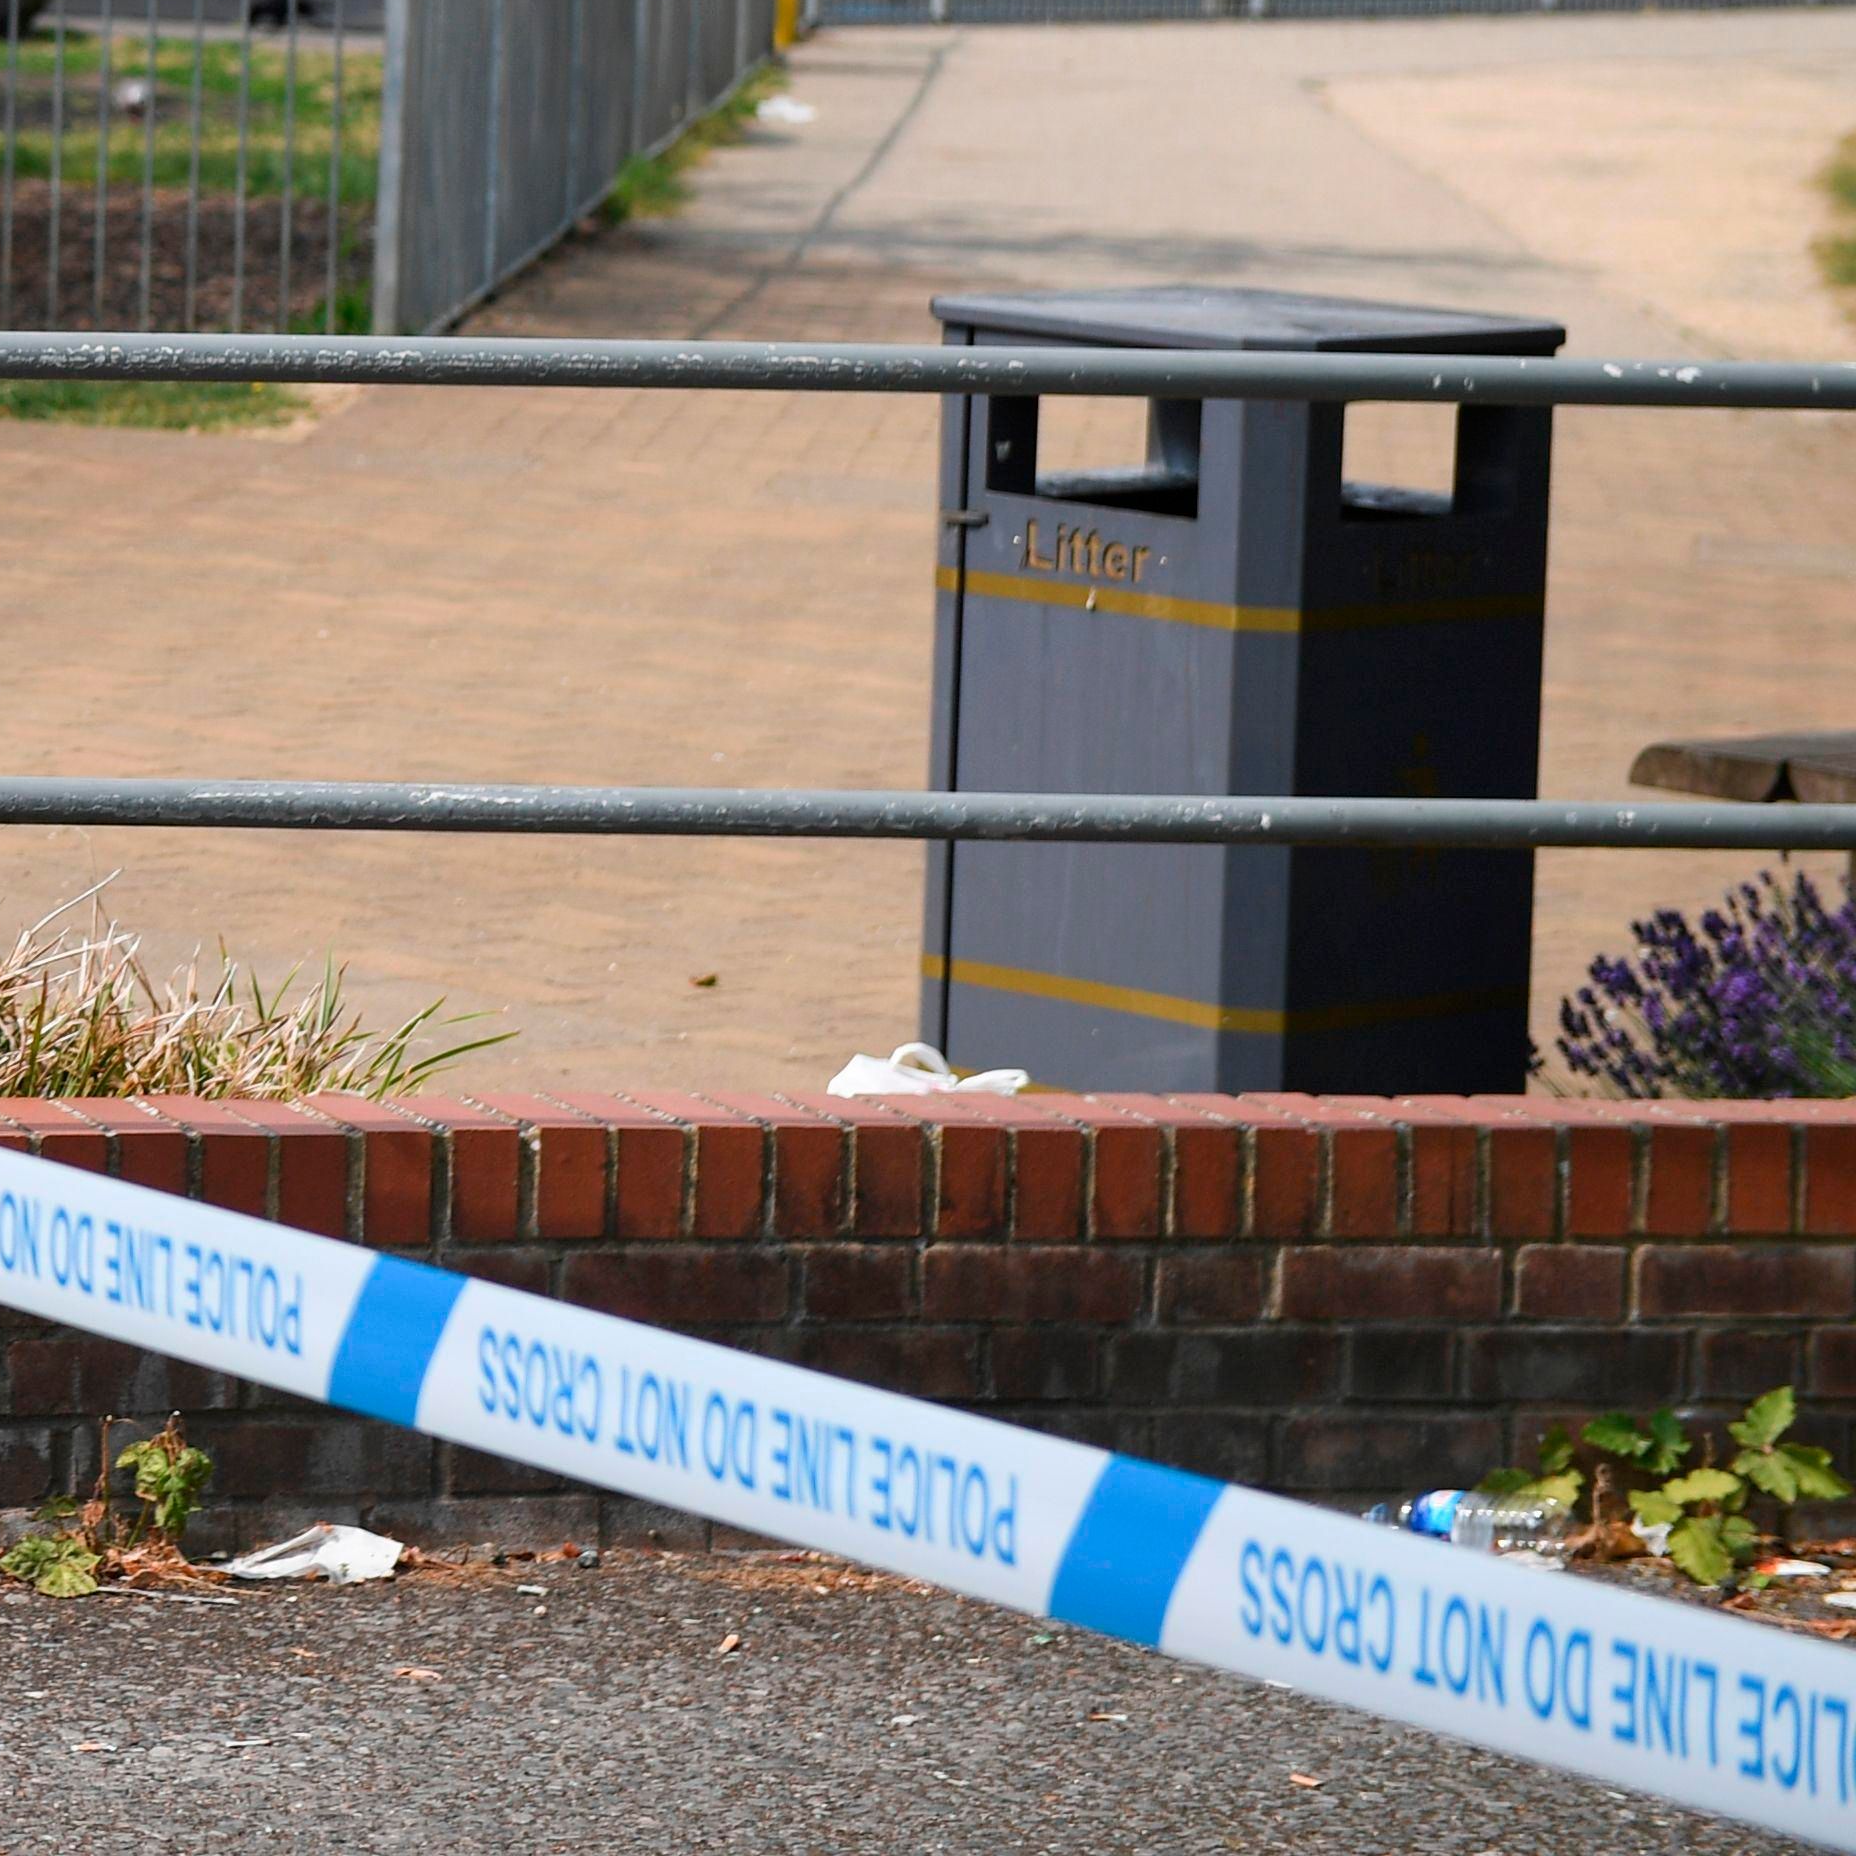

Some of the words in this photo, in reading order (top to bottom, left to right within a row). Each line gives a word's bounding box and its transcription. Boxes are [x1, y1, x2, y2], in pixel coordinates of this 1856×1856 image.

[1023, 521, 1152, 583] Litter
[48, 1204, 97, 1297] DO
[105, 1220, 177, 1317] LINE
[184, 1242, 304, 1357] POLICE
[478, 1323, 606, 1447] CROSS
[613, 1366, 694, 1469] NOT
[699, 1387, 760, 1494] DO
[768, 1407, 860, 1519] LINE
[868, 1433, 1020, 1568] POLICE
[1238, 1537, 1399, 1677] CROSS
[1409, 1584, 1510, 1709] NOT
[1520, 1613, 1595, 1734] DO
[1609, 1635, 1721, 1769] LINE
[1734, 1670, 1856, 1807] LICE
